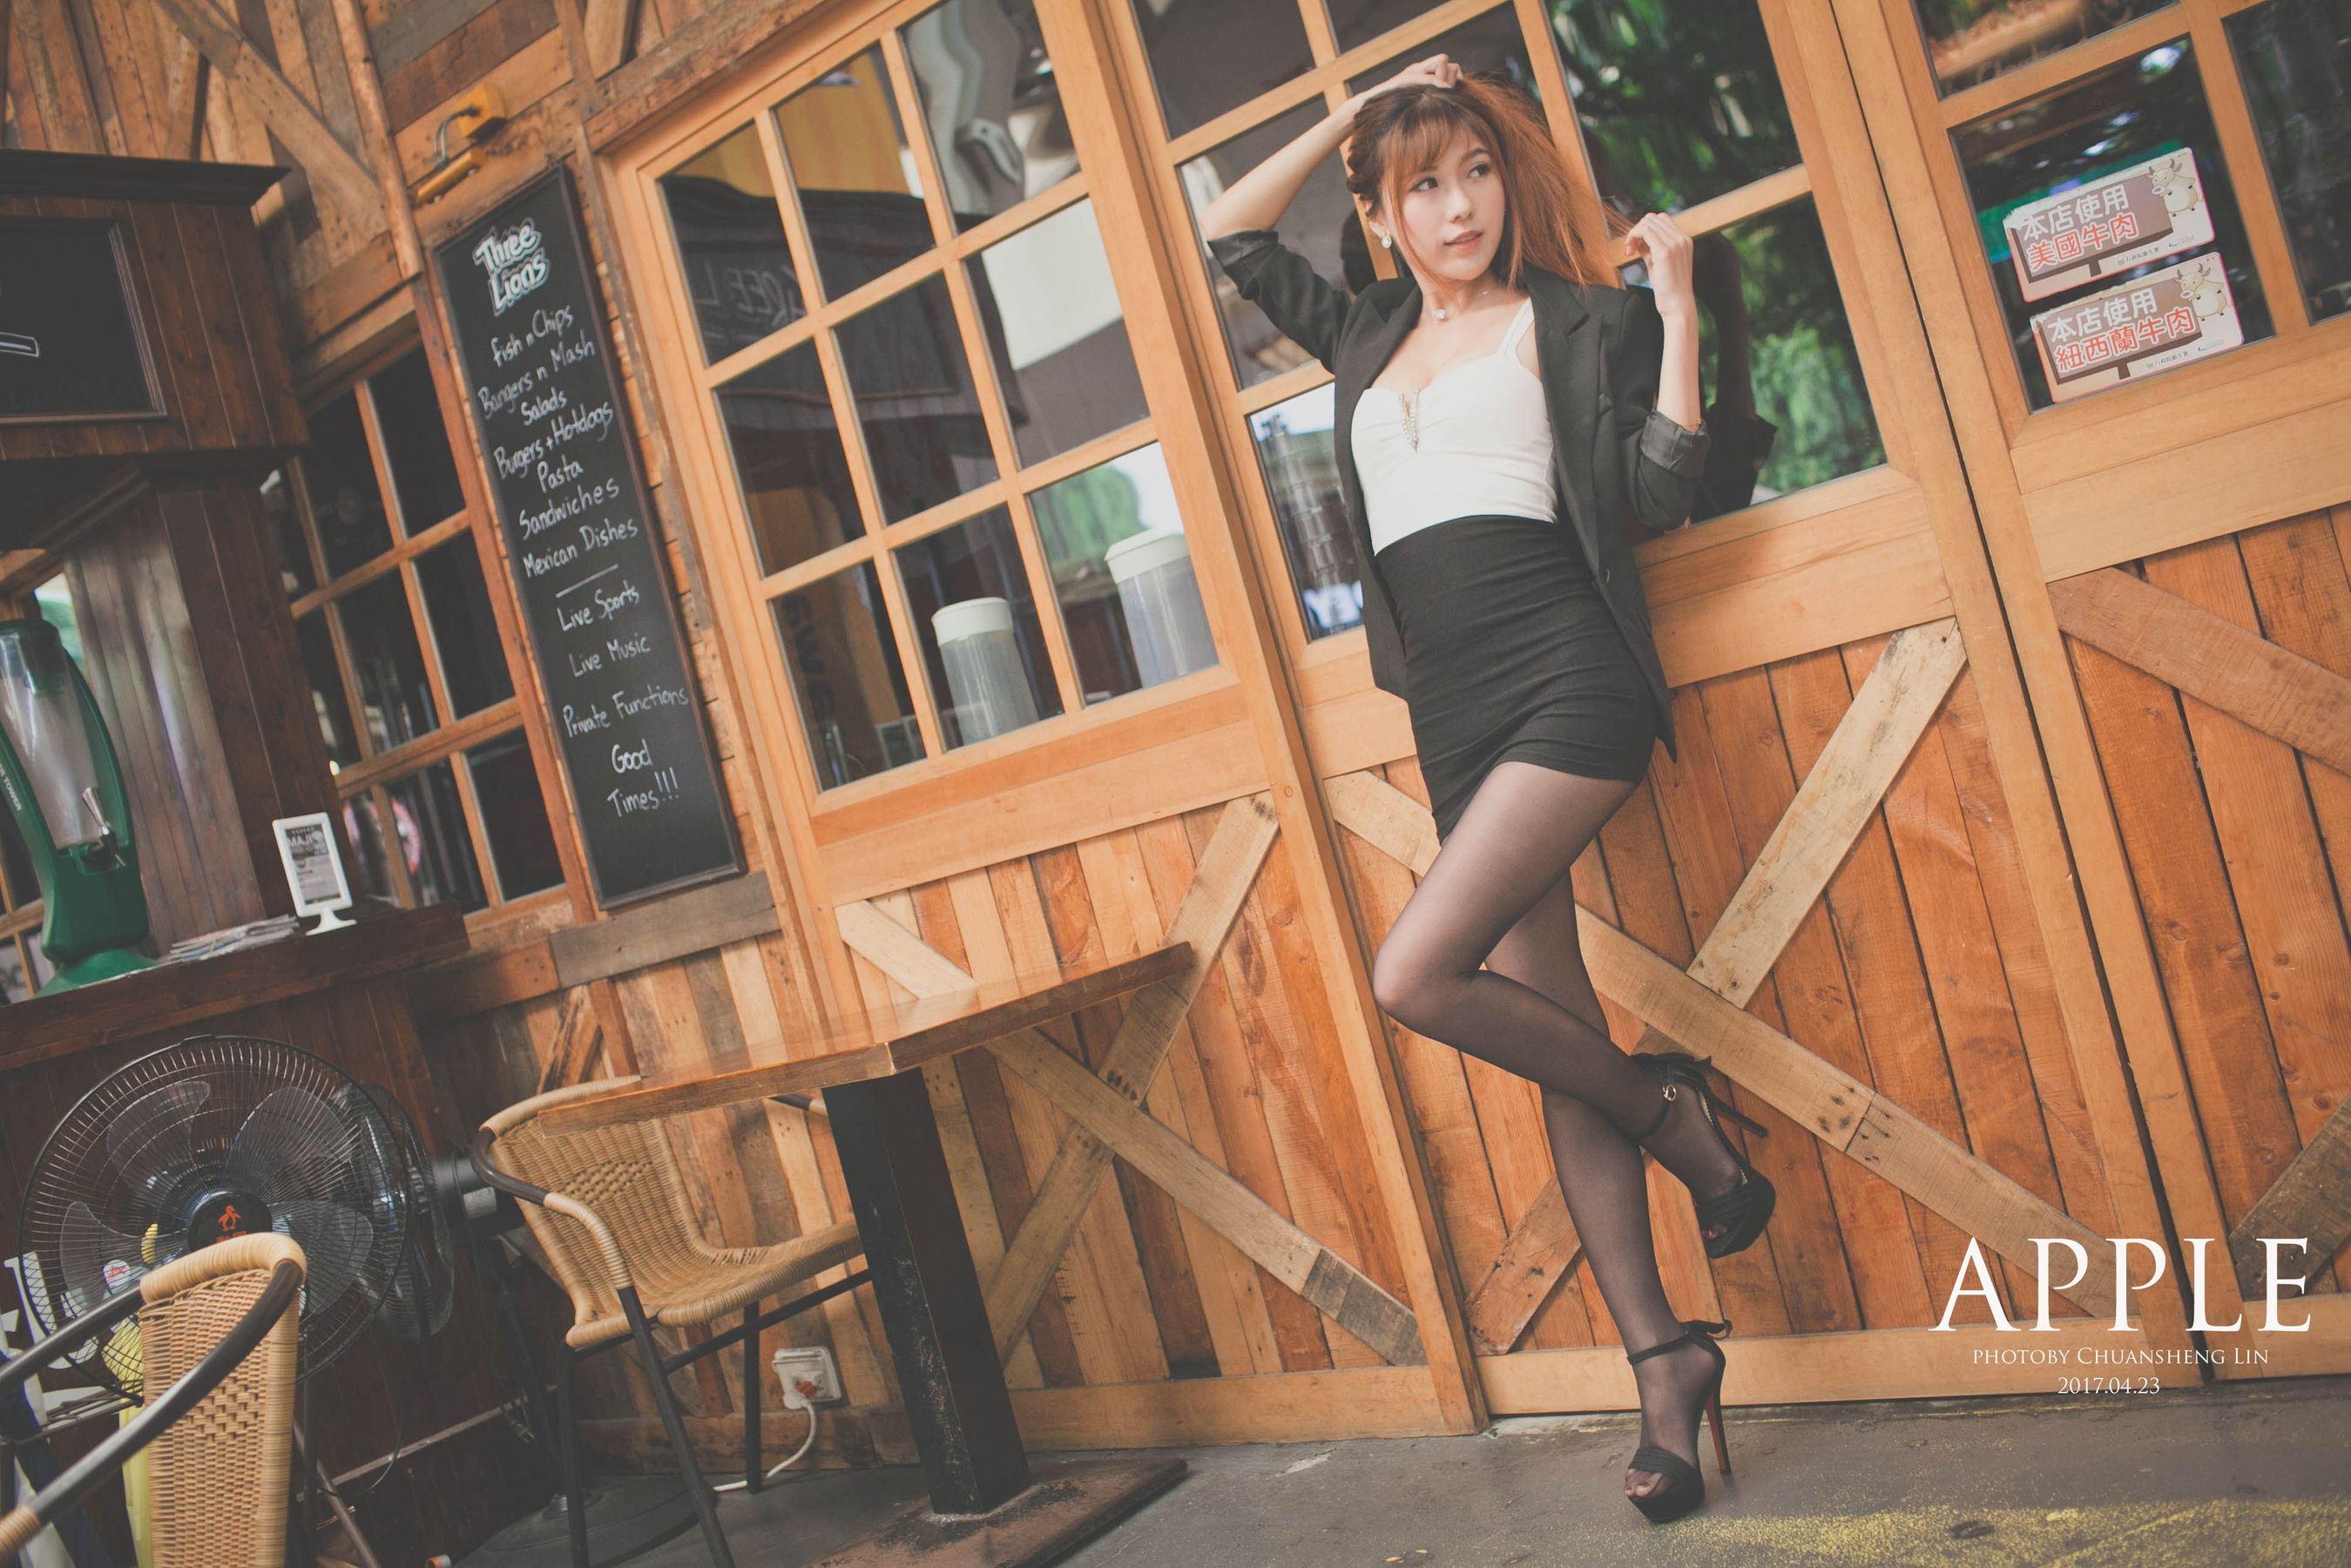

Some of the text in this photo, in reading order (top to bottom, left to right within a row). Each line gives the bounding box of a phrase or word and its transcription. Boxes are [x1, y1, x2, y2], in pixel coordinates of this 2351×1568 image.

[2023, 184, 2130, 241] 本店使用
[473, 221, 541, 274] Three
[2027, 212, 2139, 271] 美國牛肉
[489, 250, 550, 314] Lions
[532, 305, 574, 338] Chips
[2047, 287, 2158, 342] 本店使用
[2055, 307, 2196, 373] 紐西蘭牛肉
[478, 328, 596, 421] Bangers n Mash
[521, 386, 568, 426] Salads
[494, 439, 544, 479] Burgers
[551, 402, 613, 443] Hotdogs
[537, 454, 584, 493] Pasta
[519, 477, 619, 540] Sandwiches
[523, 517, 638, 579] Mexican Dishes
[557, 579, 640, 632] Live Sports
[569, 632, 651, 678] Live Music
[563, 684, 689, 738] Private Functions
[611, 739, 652, 774] Good
[607, 767, 679, 818] Times!!!
